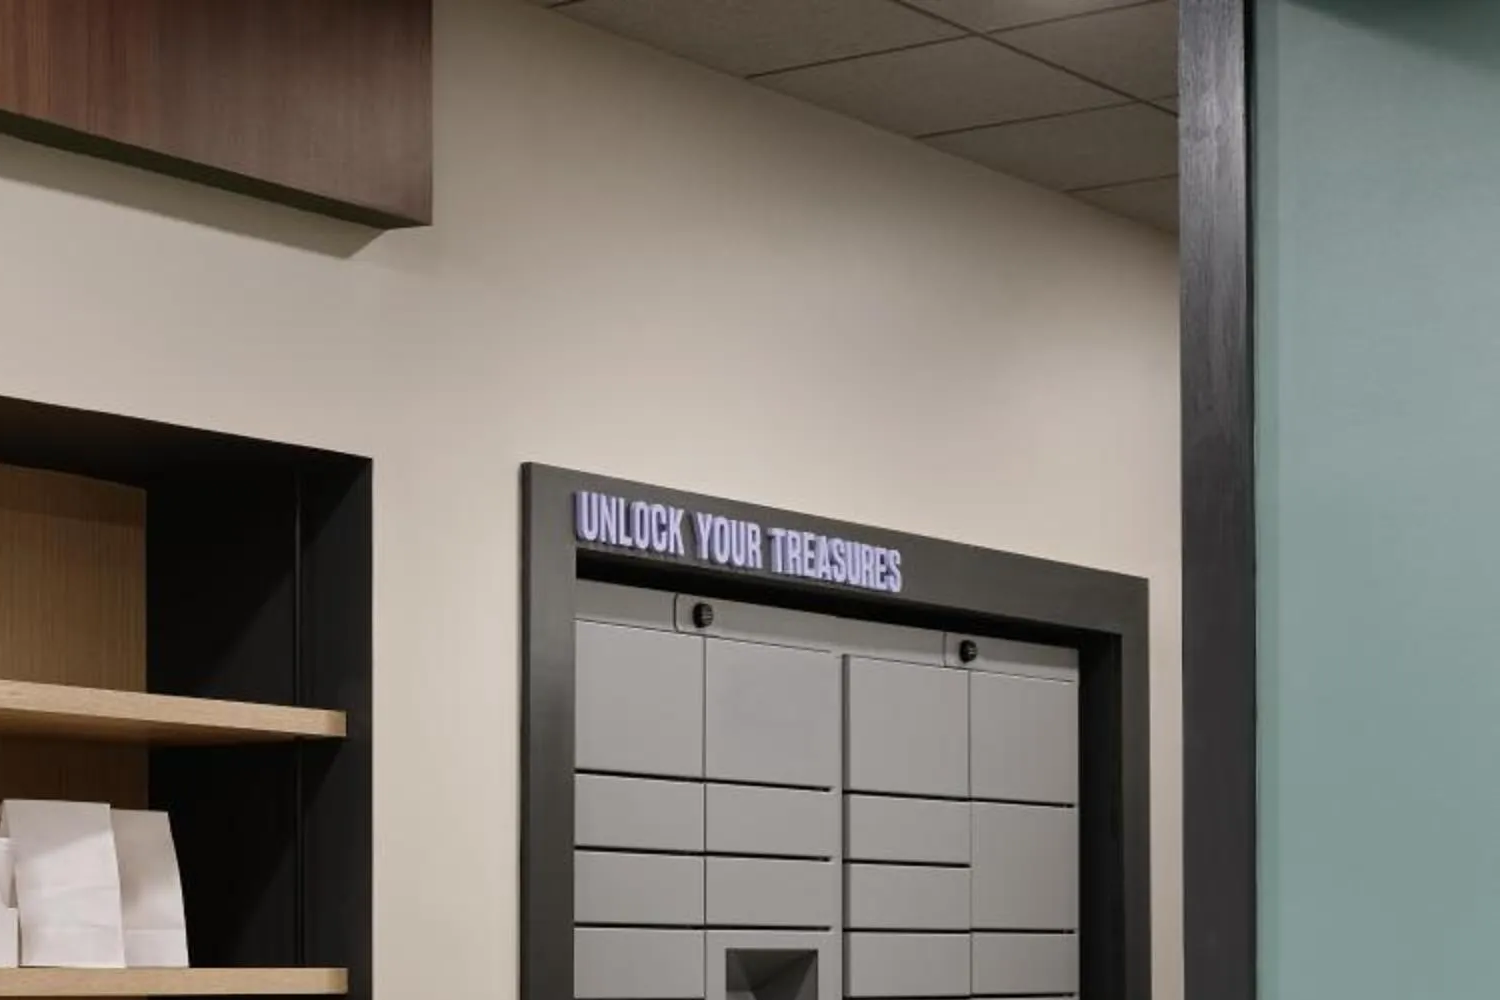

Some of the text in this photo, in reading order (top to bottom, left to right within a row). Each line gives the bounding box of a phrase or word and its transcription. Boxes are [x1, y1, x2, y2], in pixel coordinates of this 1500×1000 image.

[574, 491, 902, 593] UNLOCK YOUR TREASURES
